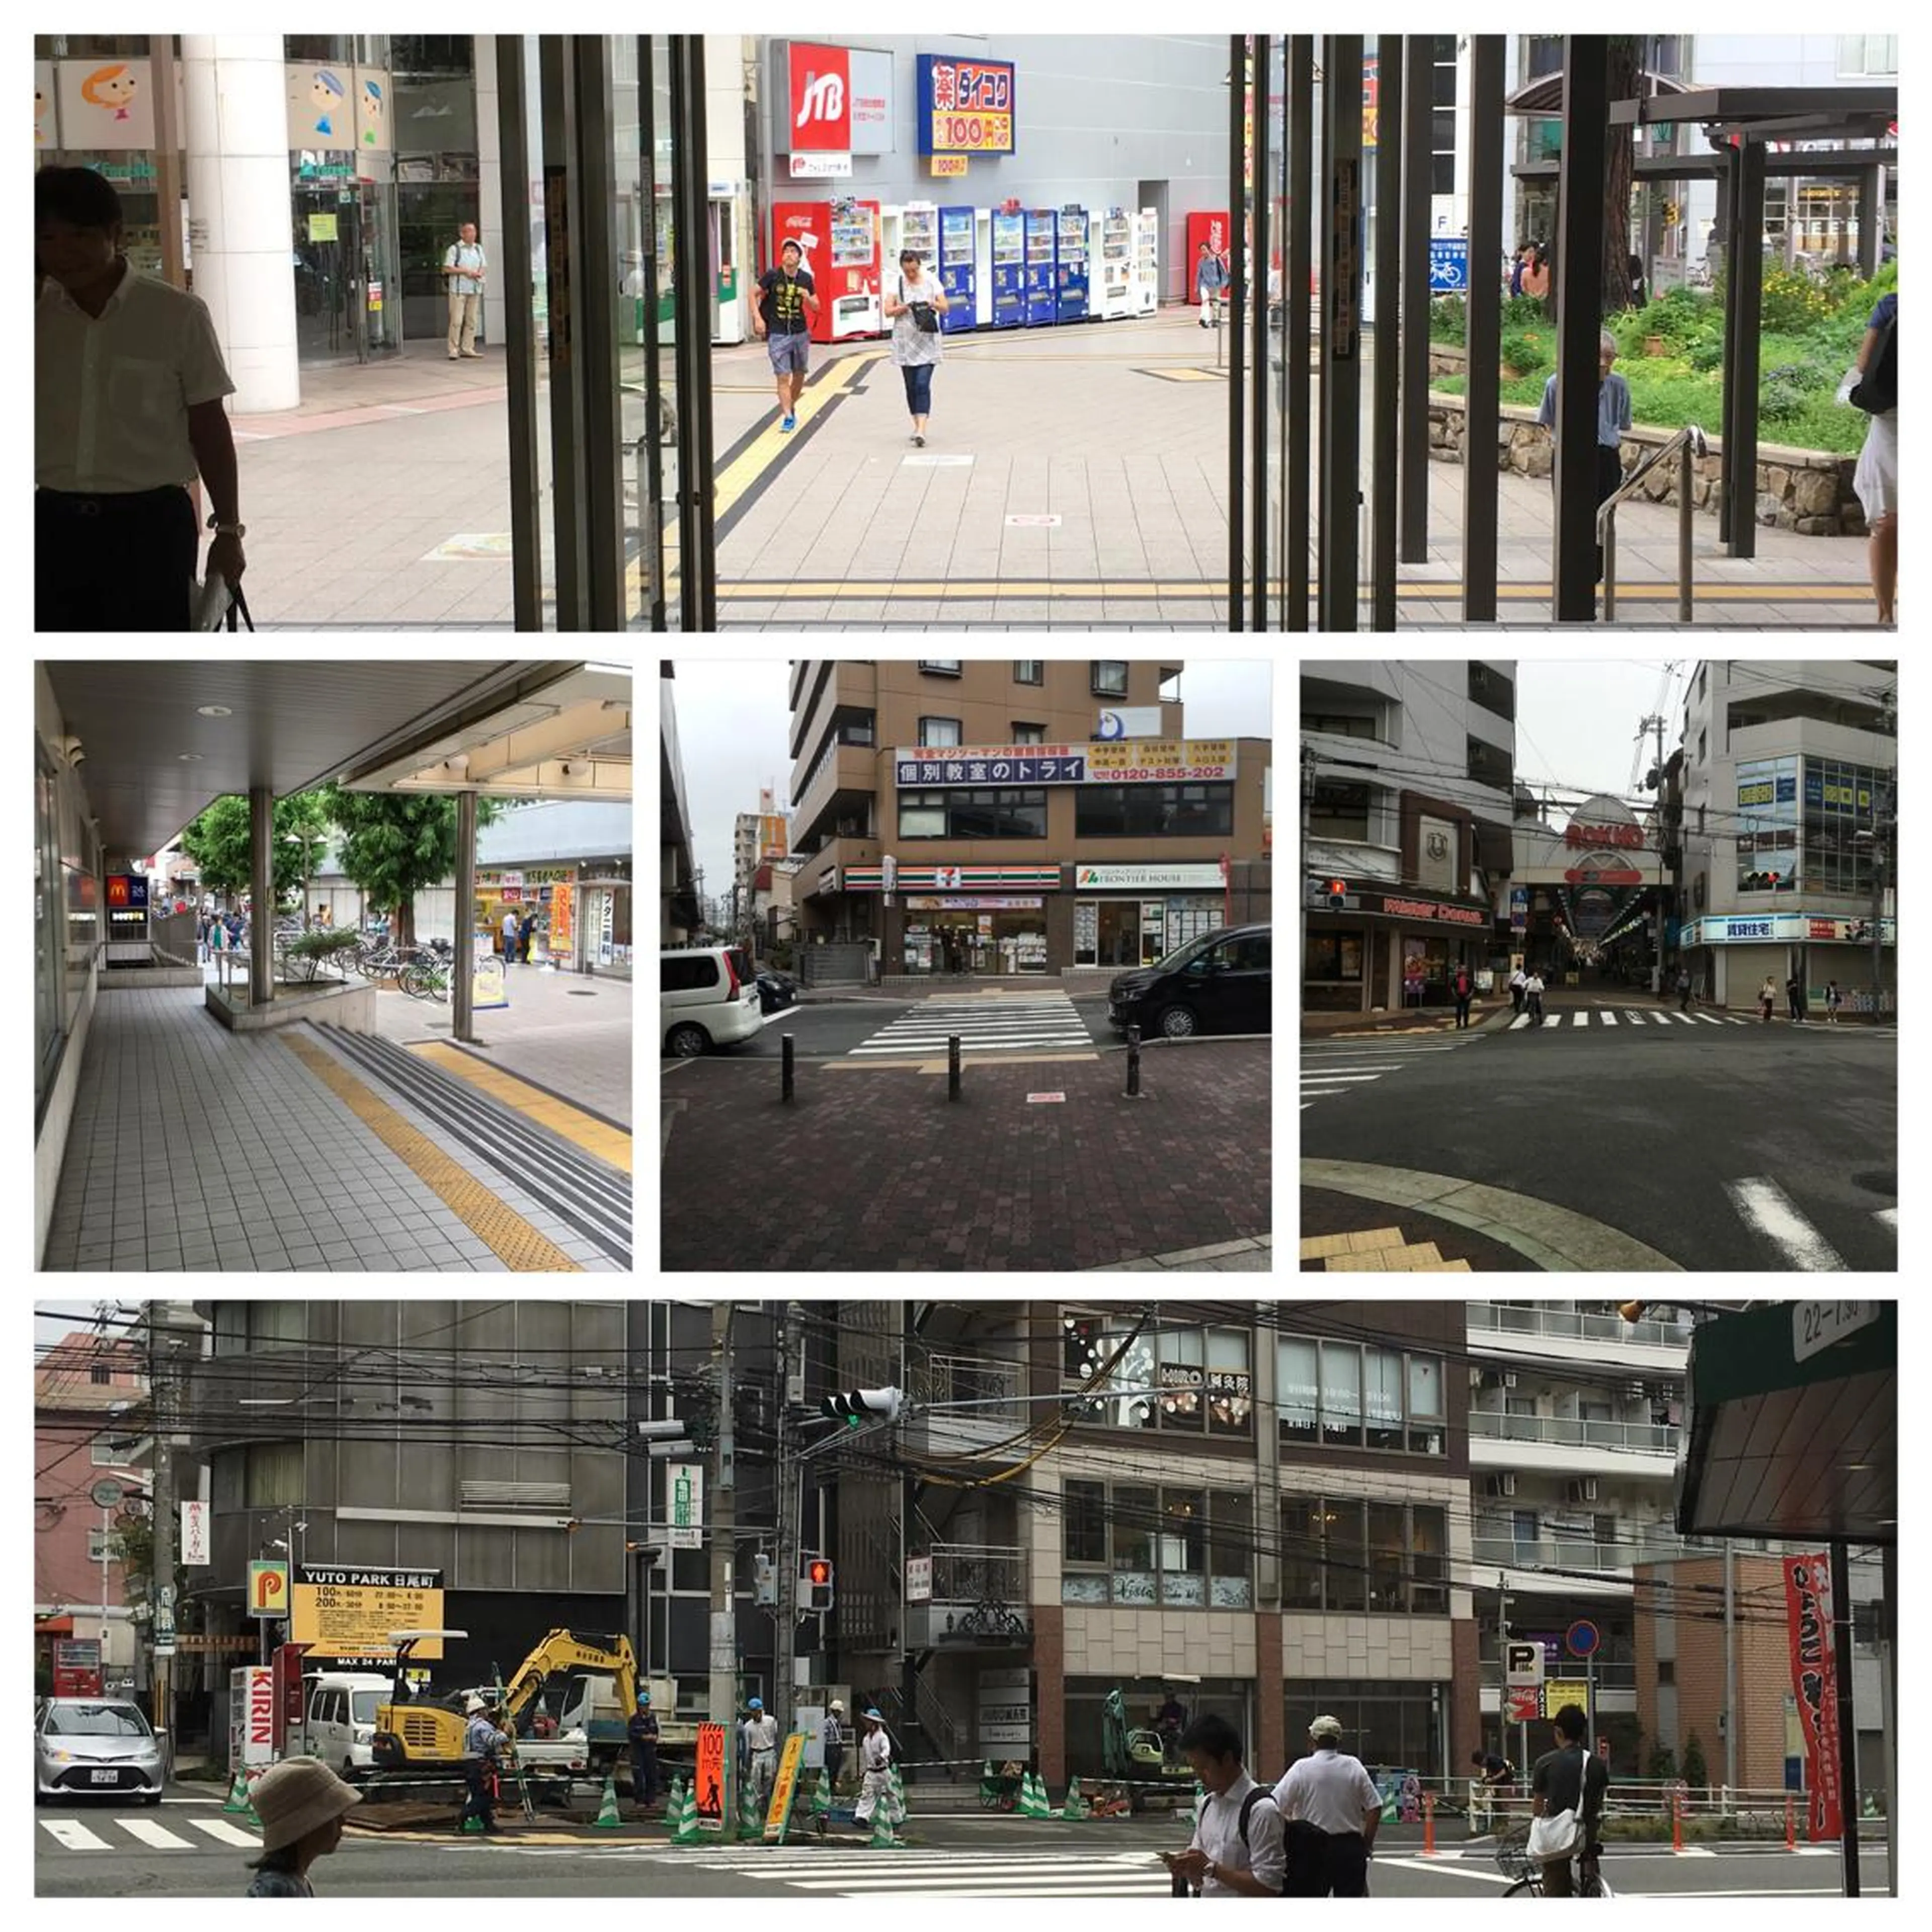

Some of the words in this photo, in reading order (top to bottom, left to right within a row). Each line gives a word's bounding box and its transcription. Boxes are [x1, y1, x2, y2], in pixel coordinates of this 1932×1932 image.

[796, 71, 844, 128] JTB
[900, 760, 1080, 782] 個別教室のトライ
[1111, 766, 1225, 780] 0120-855-202
[1727, 922, 1770, 937] 賃貸住宅
[305, 1571, 346, 1583] YUTO
[352, 1573, 390, 1585] PARK
[1510, 1646, 1535, 1672] P
[252, 1671, 272, 1744] KIRIN
[703, 1733, 723, 1755] 100
